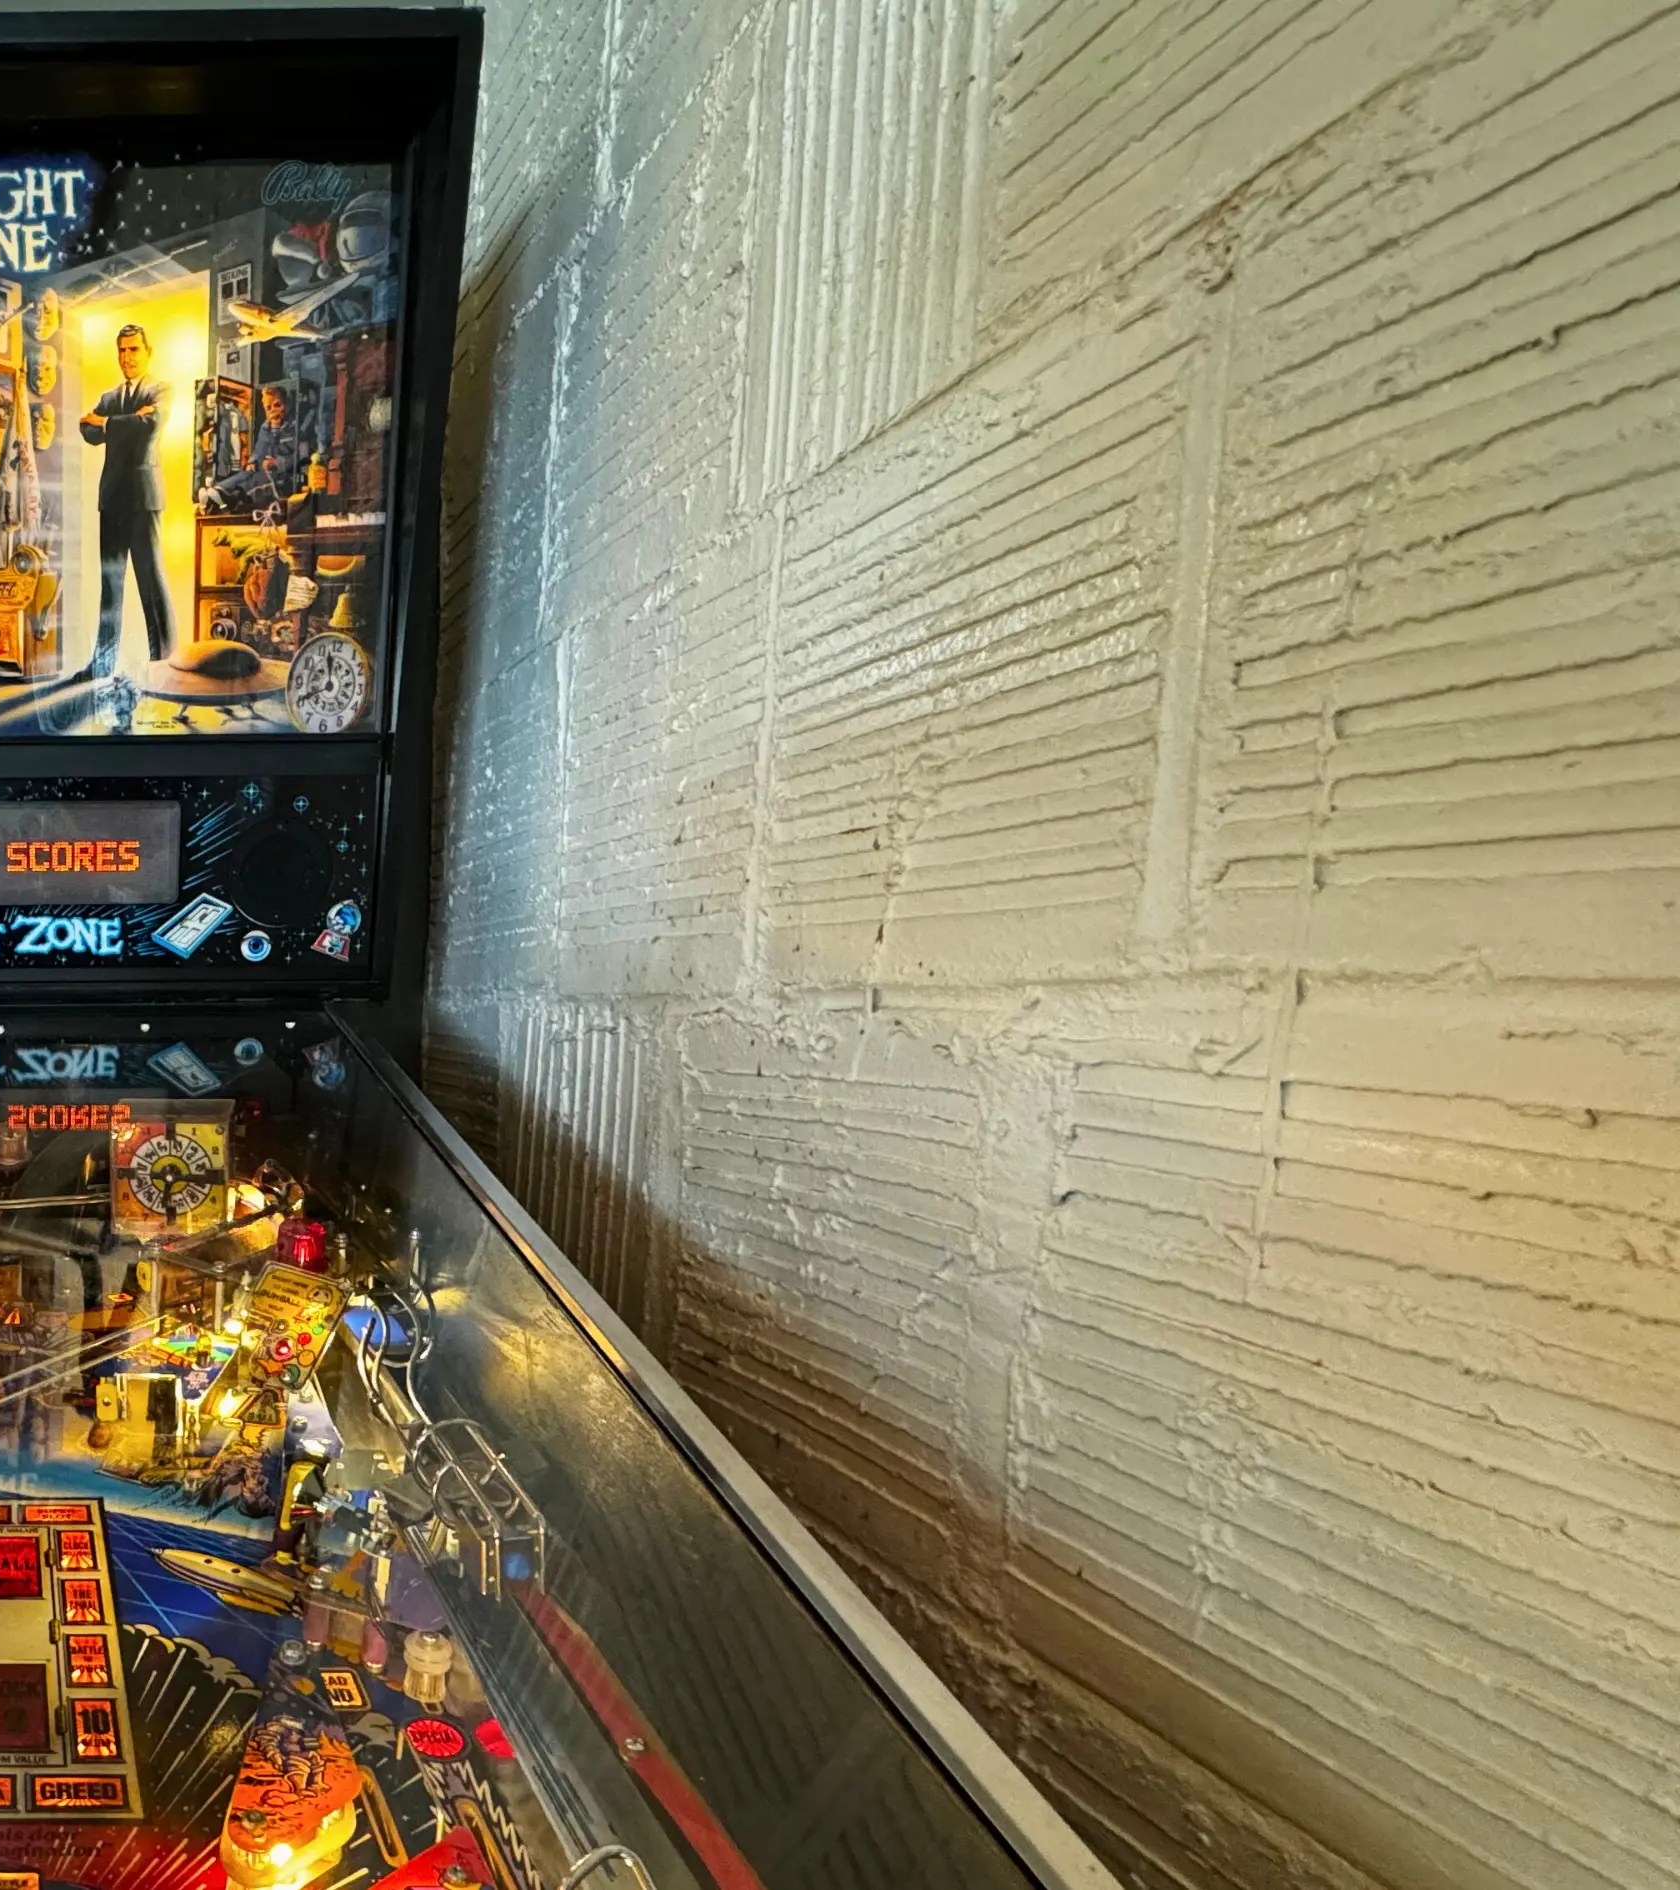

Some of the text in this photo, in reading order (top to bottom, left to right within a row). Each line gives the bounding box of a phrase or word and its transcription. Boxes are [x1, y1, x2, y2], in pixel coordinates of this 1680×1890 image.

[261, 159, 353, 212] Bally
[6, 840, 141, 873] SCORES
[12, 914, 125, 956] ZONE
[63, 1541, 89, 1550] CLOCK
[73, 1589, 93, 1599] THE
[324, 1676, 347, 1686] AD
[329, 1688, 354, 1702] ND
[79, 1708, 110, 1734] 10
[13, 1754, 48, 1764] VALUE
[40, 1782, 118, 1800] GREED
